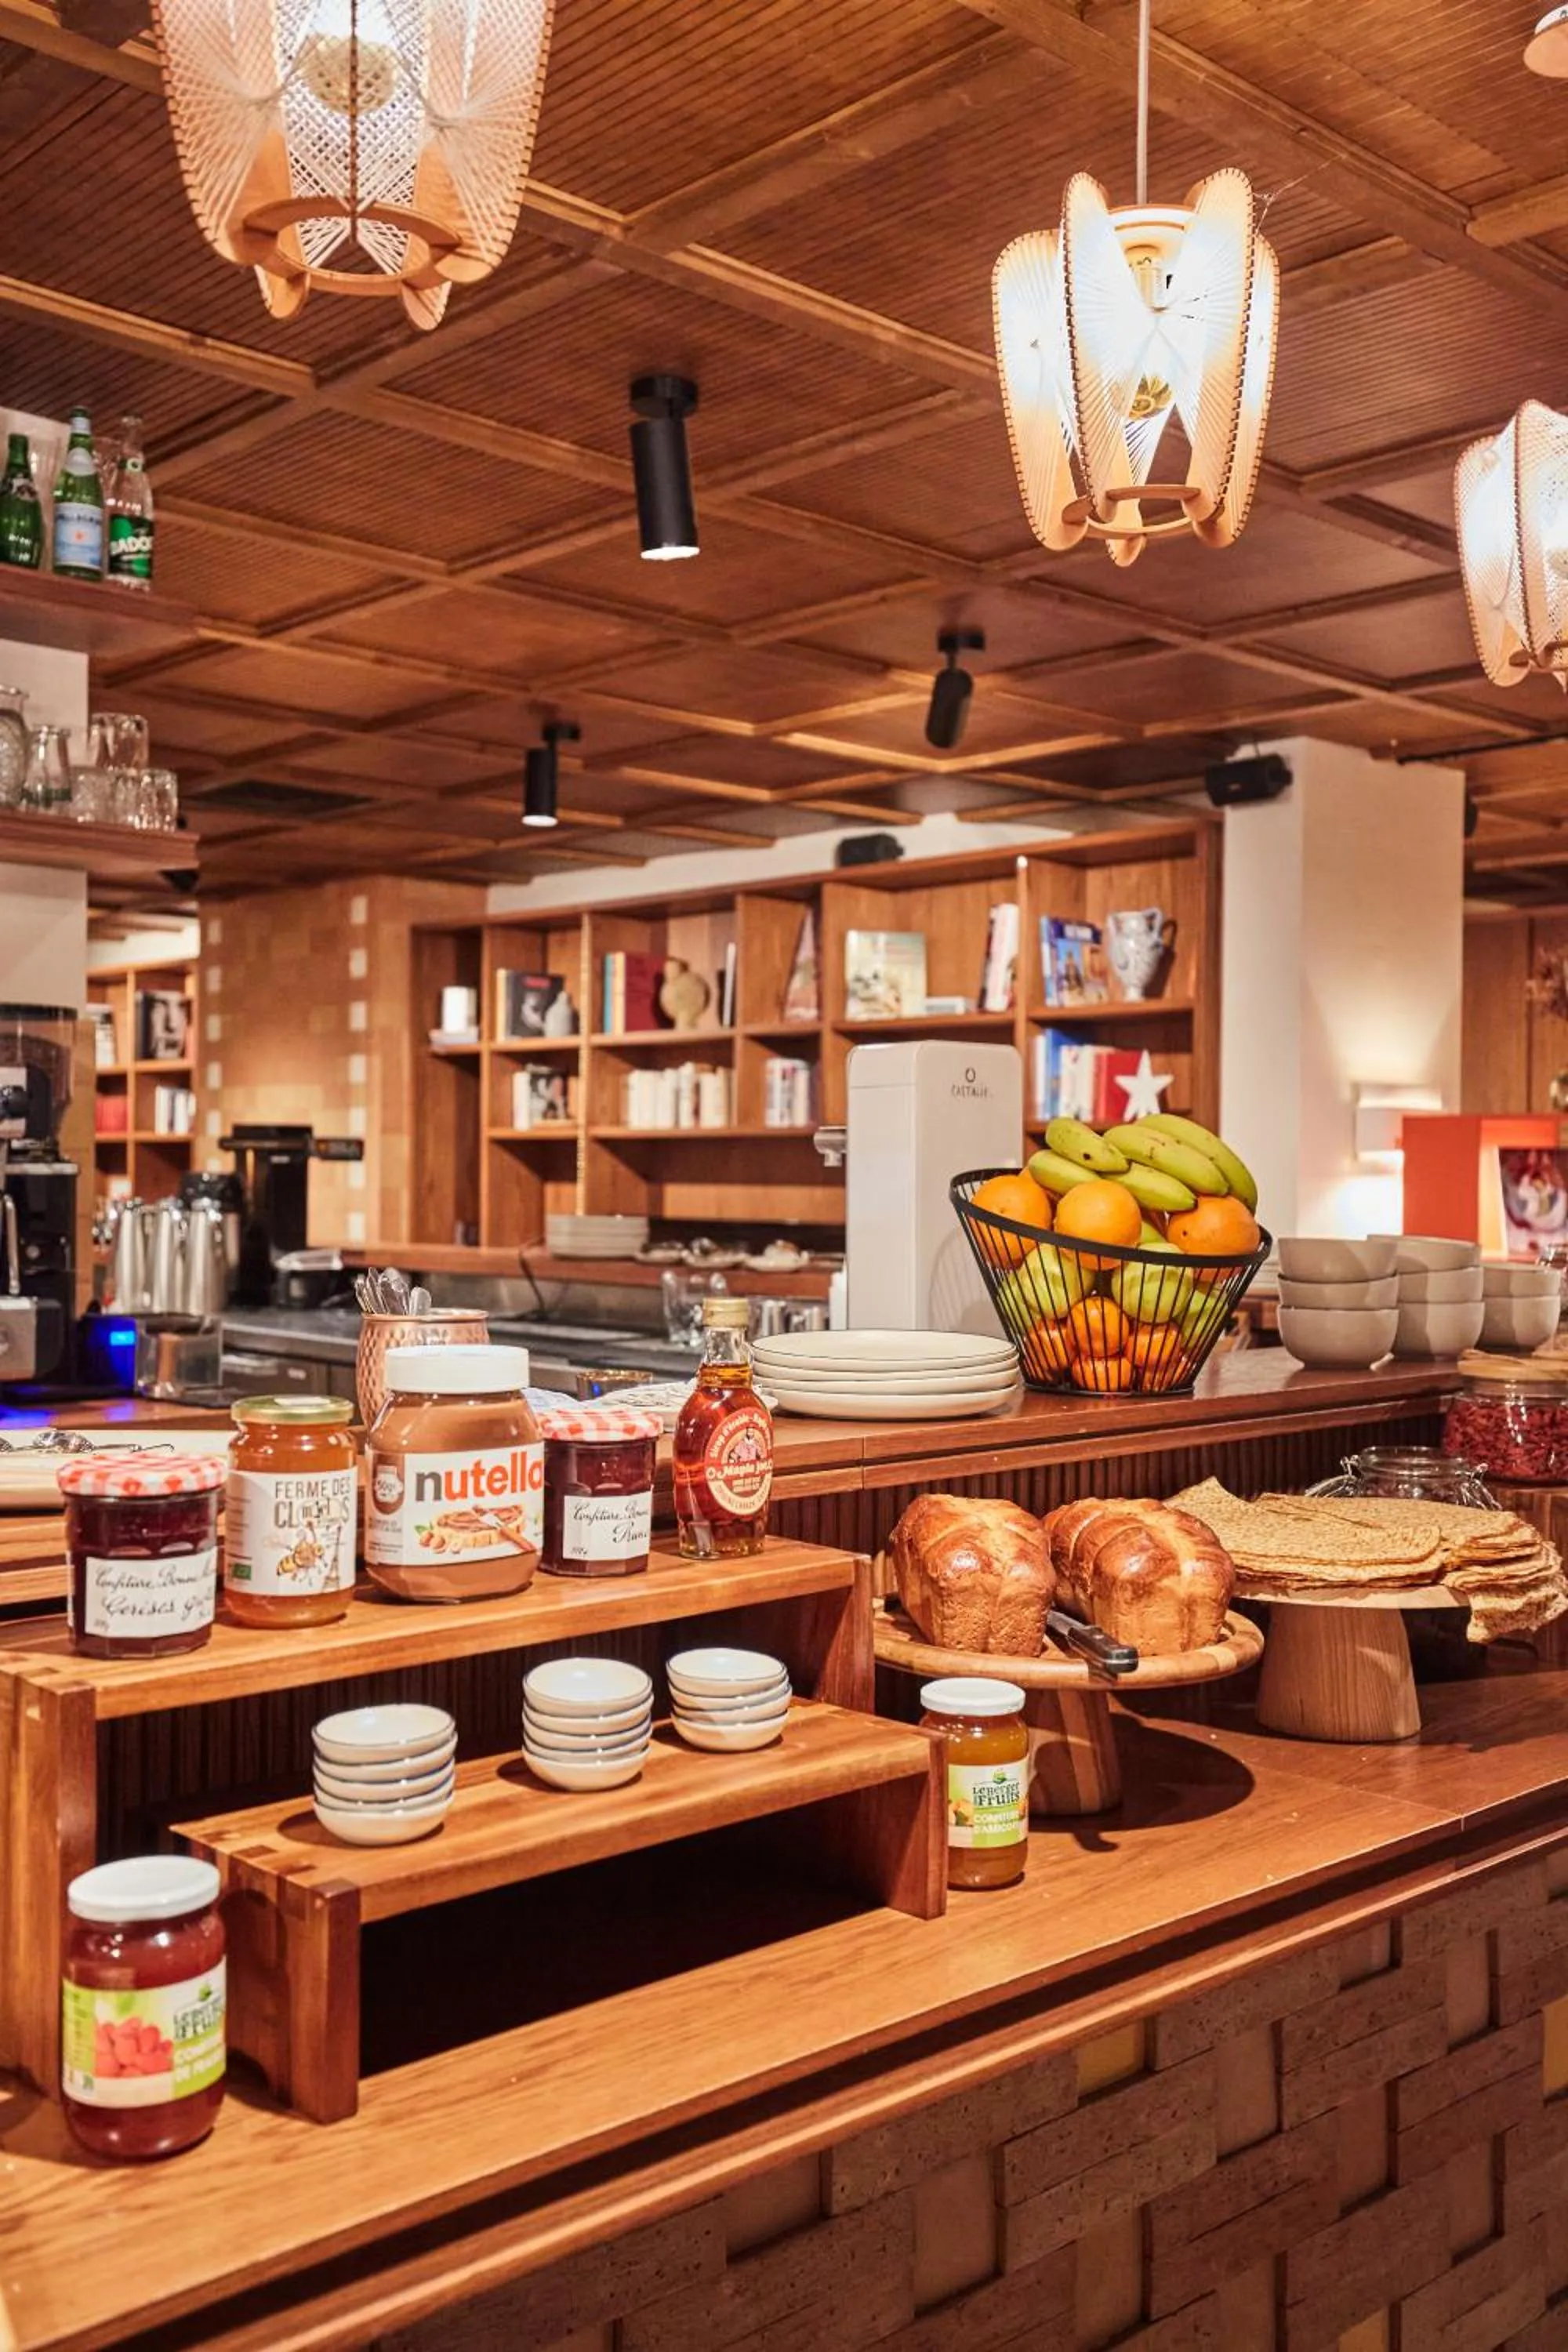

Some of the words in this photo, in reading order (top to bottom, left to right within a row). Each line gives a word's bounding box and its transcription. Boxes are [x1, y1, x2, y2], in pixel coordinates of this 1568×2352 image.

[275, 1479, 328, 1499] FERME
[332, 1476, 351, 1496] DES
[415, 1451, 543, 1501] nutella
